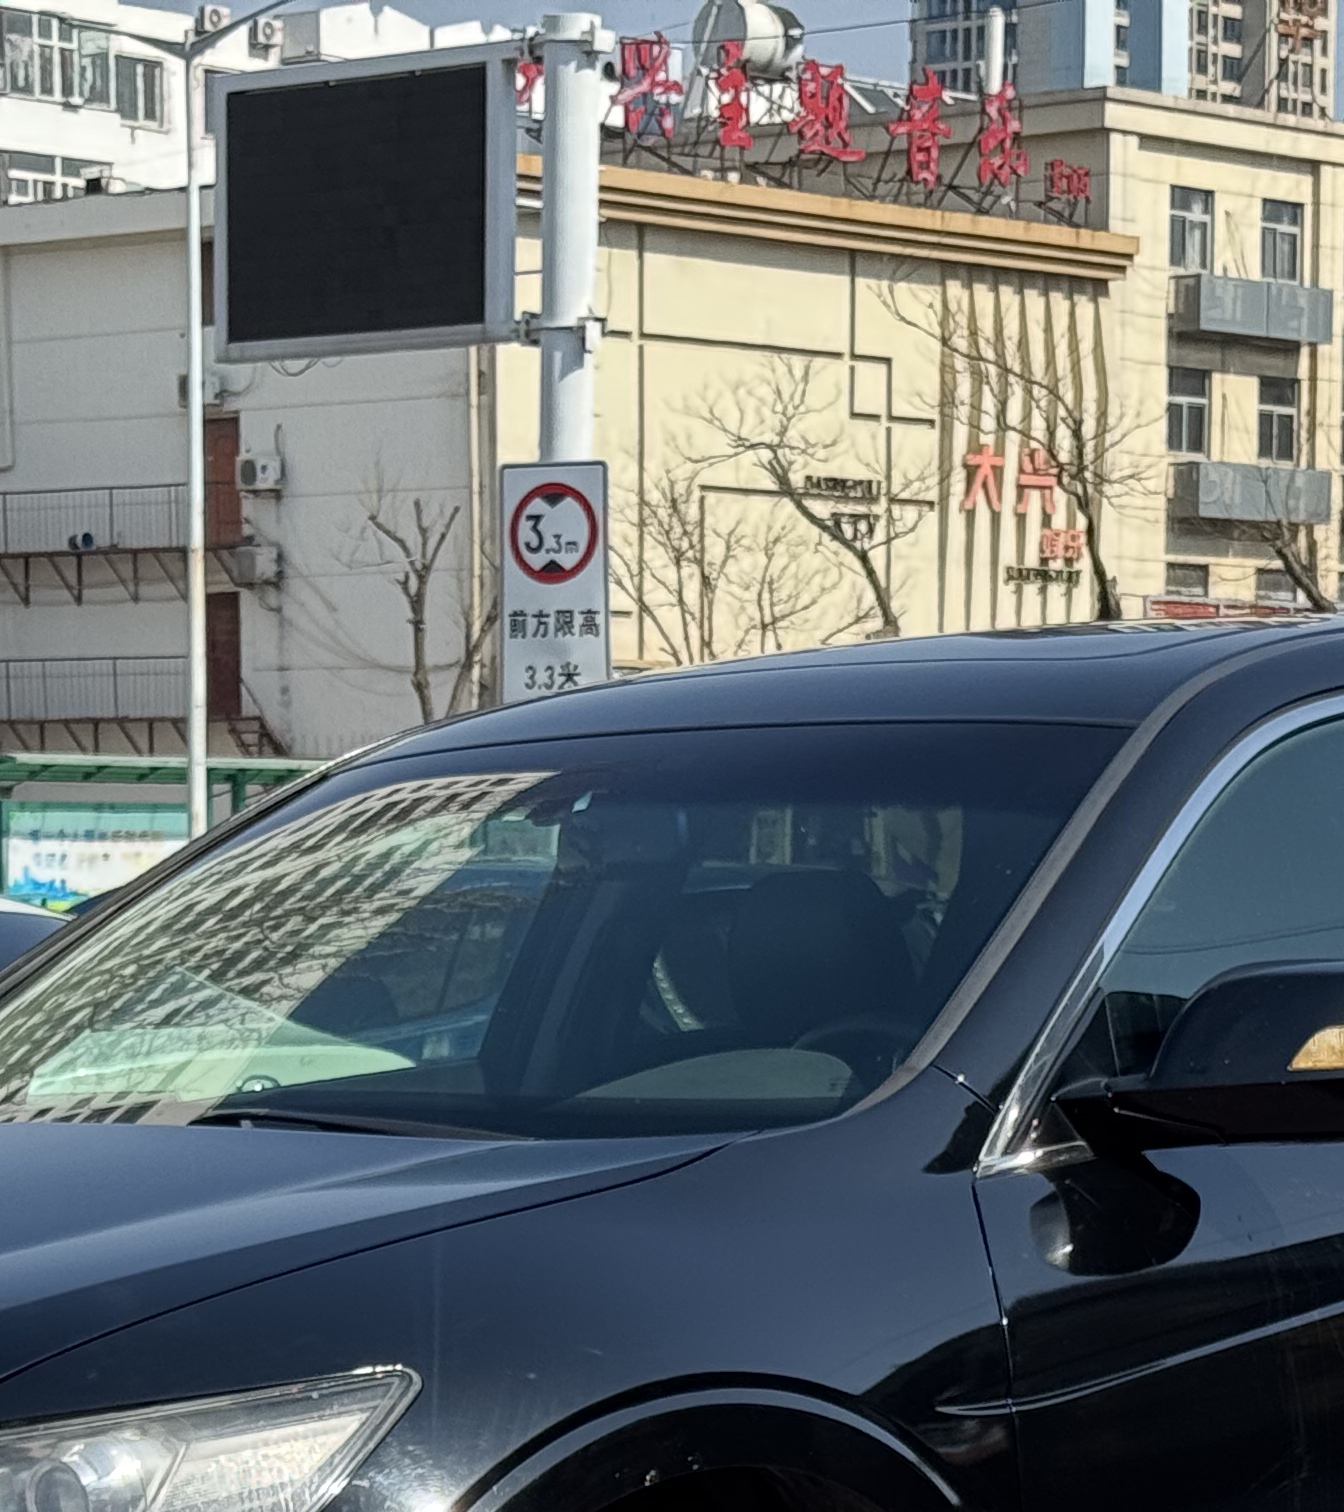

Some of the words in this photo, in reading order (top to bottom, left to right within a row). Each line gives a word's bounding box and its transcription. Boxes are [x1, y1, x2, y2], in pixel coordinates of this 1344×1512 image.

[524, 514, 580, 555] 3.3m
[508, 608, 601, 639] 前方限高
[524, 661, 582, 691] 3.3米
